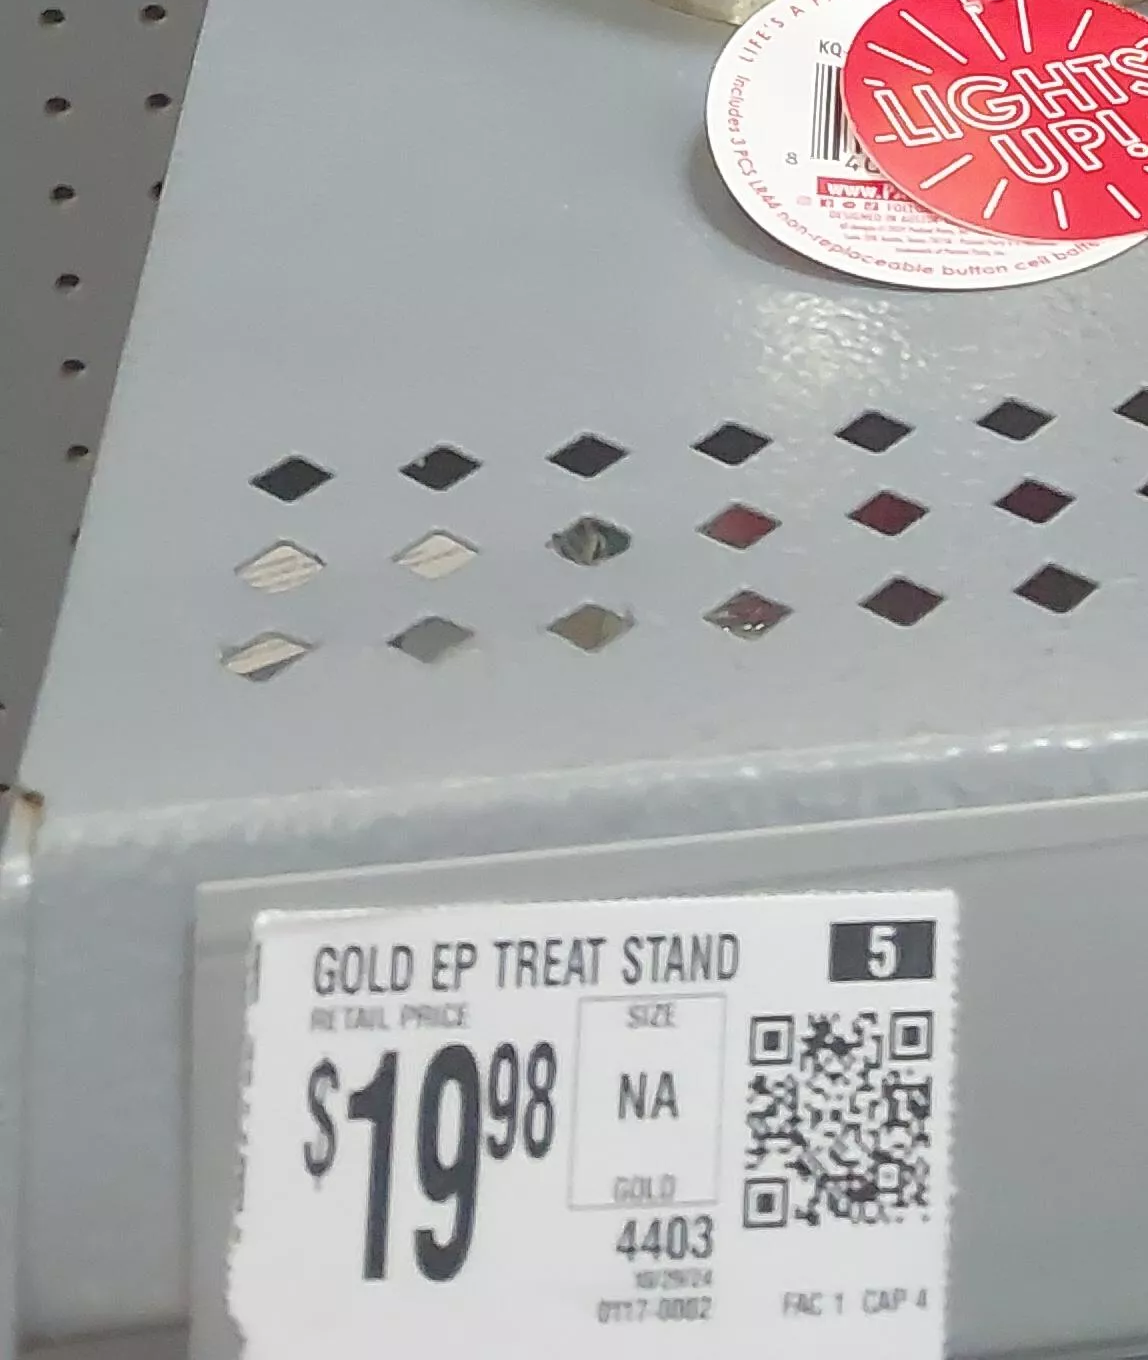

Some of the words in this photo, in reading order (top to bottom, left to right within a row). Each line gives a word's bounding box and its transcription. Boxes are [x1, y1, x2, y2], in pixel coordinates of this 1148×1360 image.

[739, 16, 786, 64] LIFE'S
[789, 4, 806, 18] A
[727, 74, 752, 133] Includes
[730, 136, 747, 146] 3
[733, 149, 759, 177] PCS
[785, 151, 799, 166] 8
[748, 178, 783, 210] LR44
[777, 210, 934, 275] non-replaceable
[941, 262, 1009, 277] button
[1014, 254, 1052, 272] cell
[314, 944, 414, 995] GOLD
[432, 942, 478, 992] EP
[494, 936, 606, 989] TREAT
[622, 933, 740, 985] STAND
[868, 925, 898, 978] 5
[310, 1006, 389, 1032] RETAIL
[401, 1003, 468, 1030] PRICE
[626, 1002, 676, 1030] SIZE
[617, 1071, 679, 1120] NA
[614, 1175, 676, 1202] GOLD
[616, 1215, 714, 1261] 4403
[861, 1288, 908, 1314] CAP
